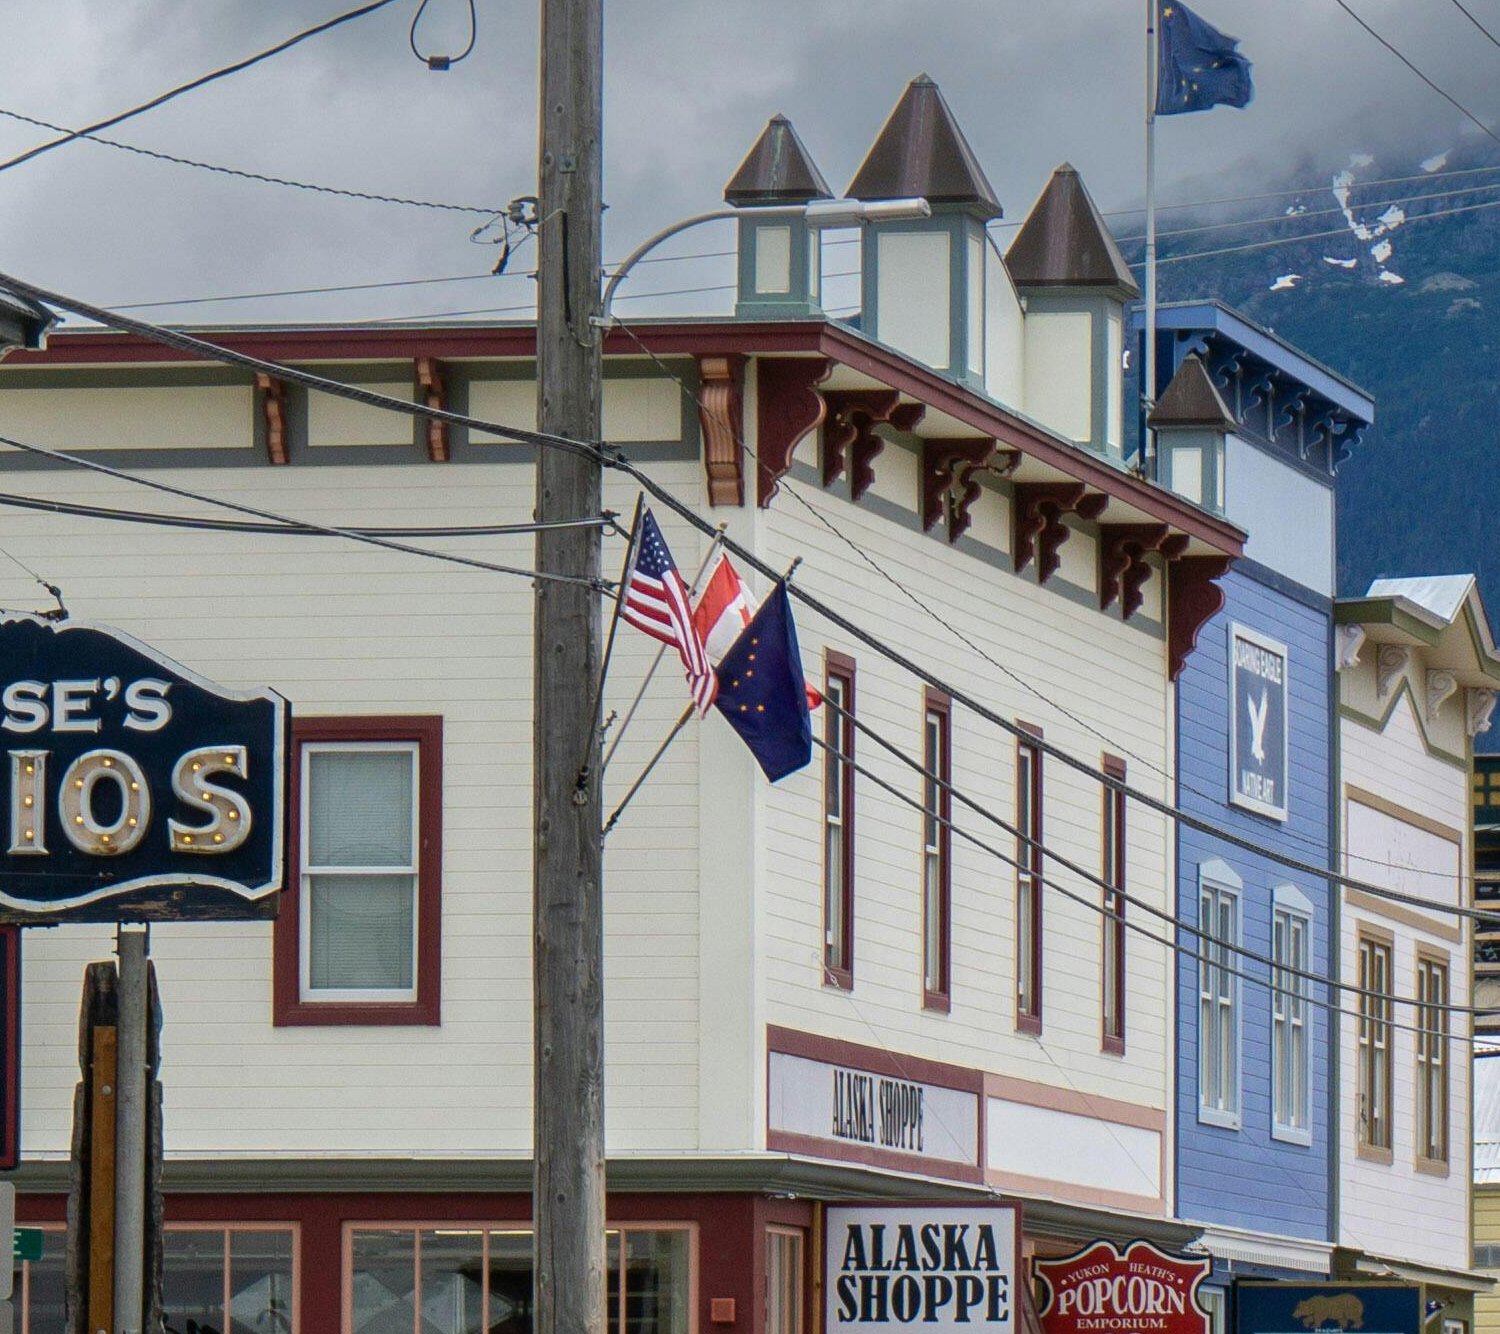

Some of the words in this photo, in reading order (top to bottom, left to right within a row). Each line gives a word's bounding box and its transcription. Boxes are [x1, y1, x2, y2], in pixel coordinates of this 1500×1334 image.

[832, 1068, 875, 1143] ALASKA
[879, 1079, 924, 1152] SHOPPE
[841, 1223, 1000, 1272] ALASKA
[1058, 1275, 1186, 1315] POPCORN
[1068, 1262, 1110, 1283] YUKON
[1129, 1262, 1176, 1282] HEATH'S
[836, 1274, 1009, 1323] SHOPPE
